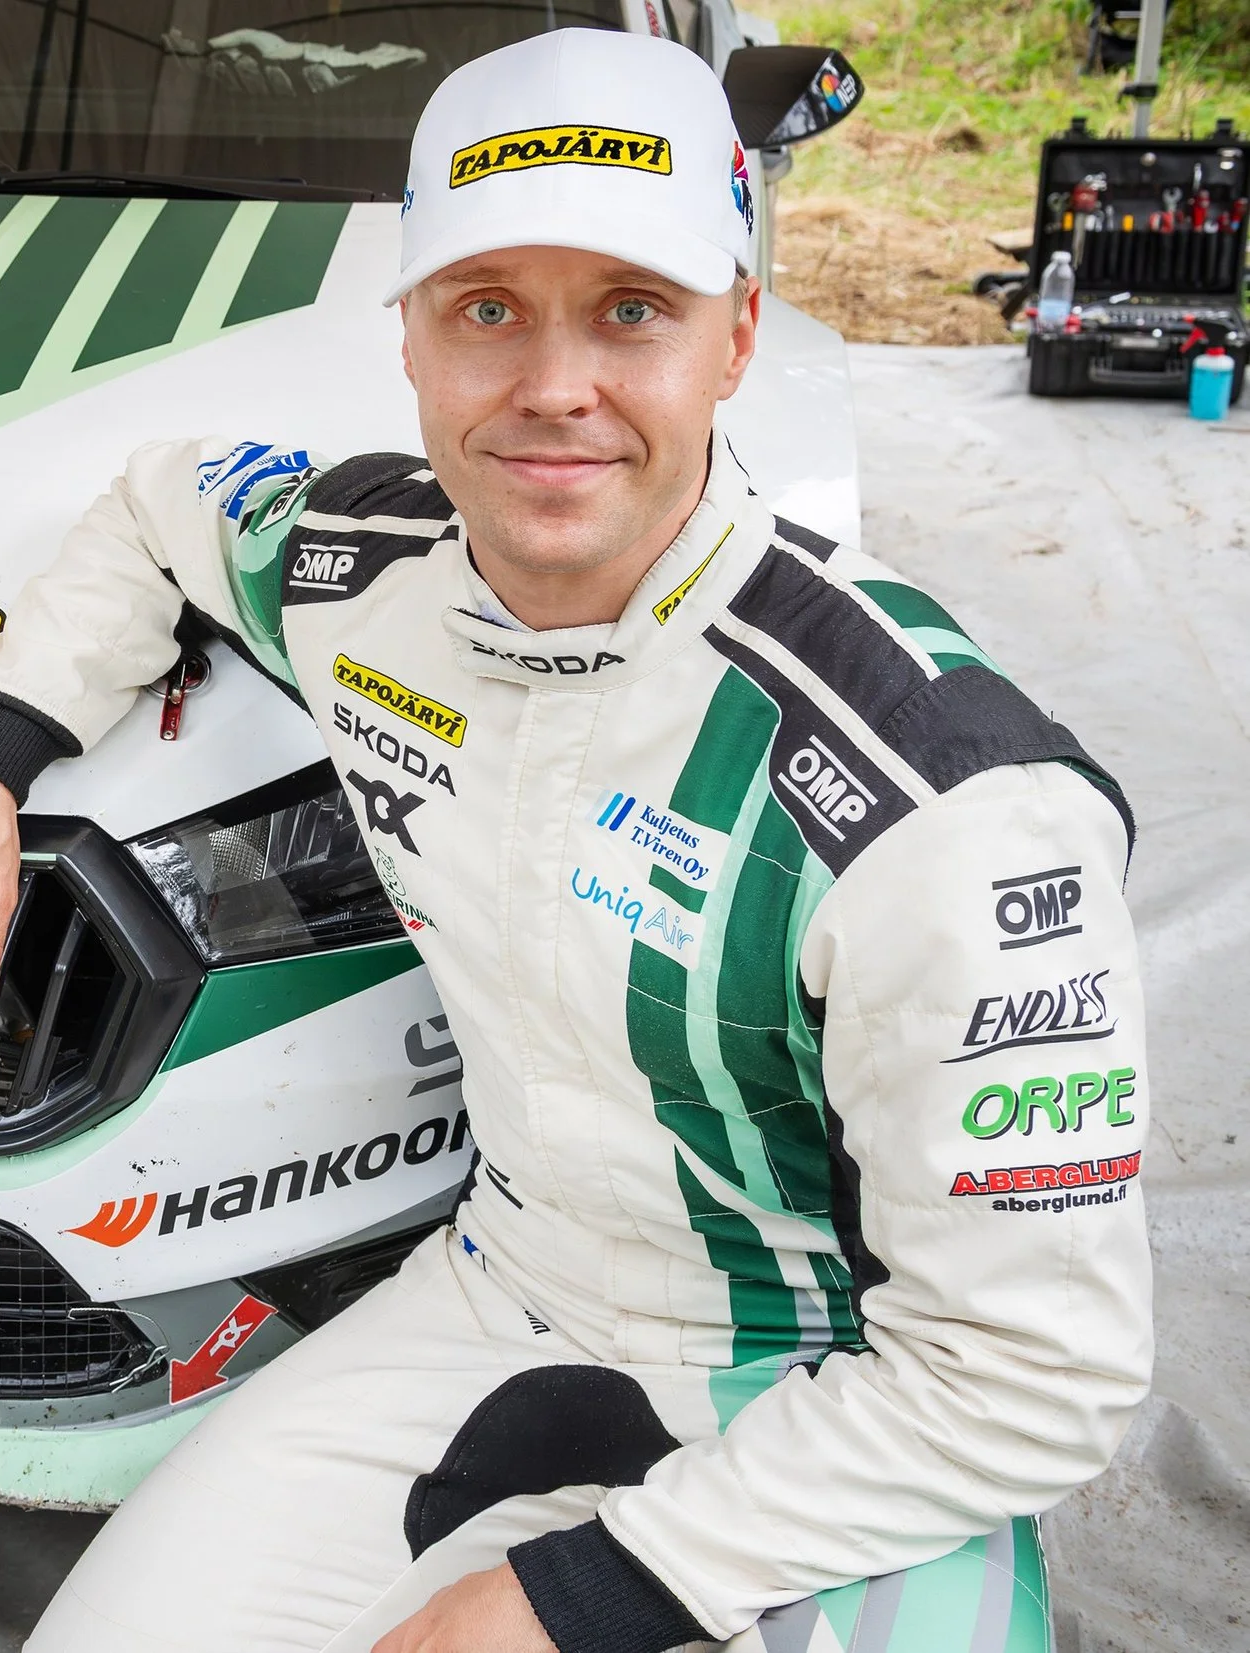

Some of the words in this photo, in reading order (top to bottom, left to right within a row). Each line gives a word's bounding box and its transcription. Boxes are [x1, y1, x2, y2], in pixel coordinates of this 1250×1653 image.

[291, 551, 355, 582] OMP
[788, 747, 867, 823] OMP
[630, 825, 683, 866] T.Viren
[682, 857, 710, 881] Oy
[639, 804, 701, 849] Kuljetus
[995, 878, 1082, 936] OMP
[961, 969, 1110, 1047] ENDLESS
[960, 1066, 1136, 1141] ORPE
[991, 1183, 1128, 1214] aberglund.fi
